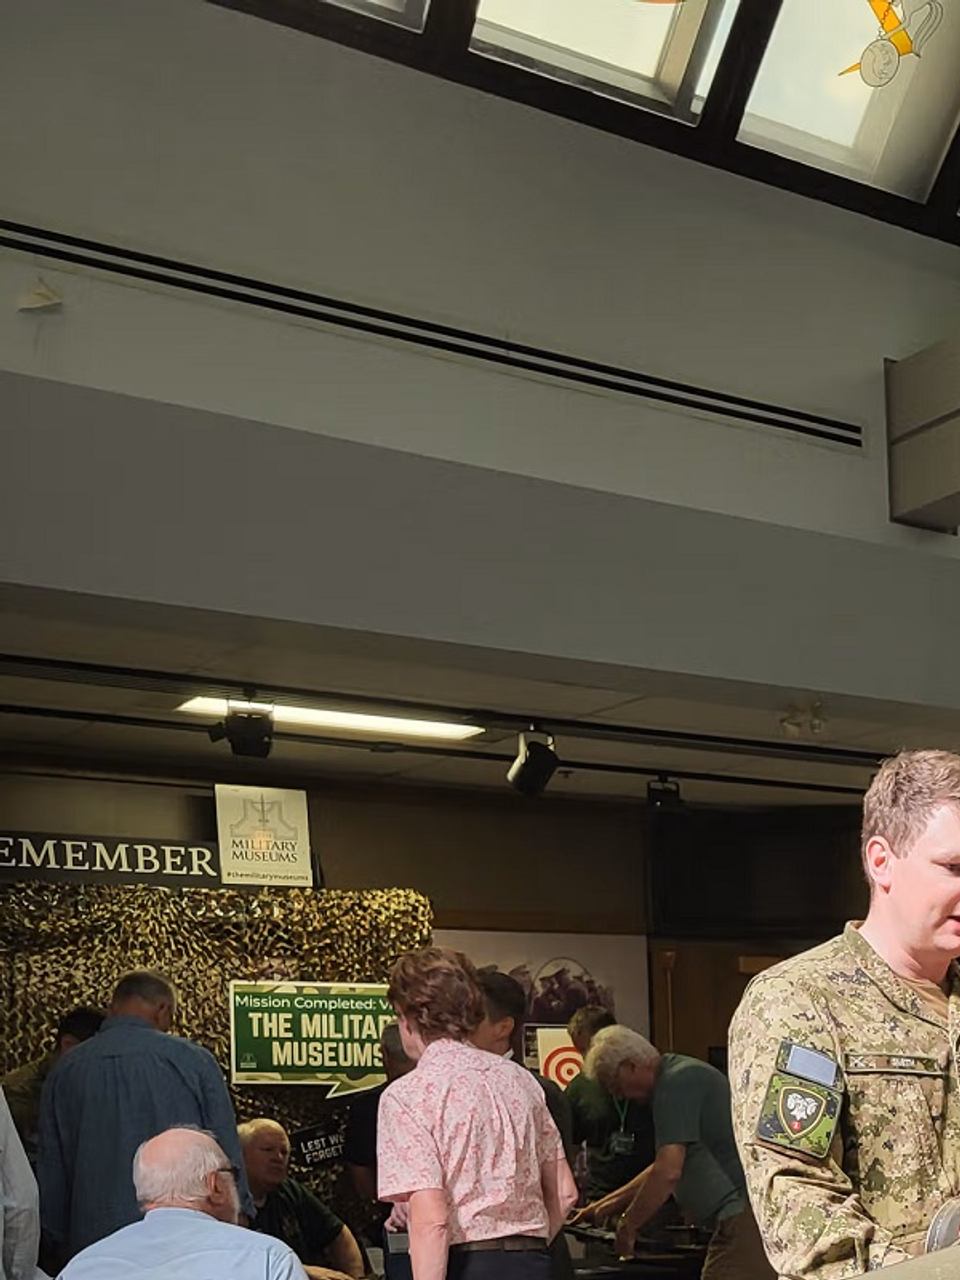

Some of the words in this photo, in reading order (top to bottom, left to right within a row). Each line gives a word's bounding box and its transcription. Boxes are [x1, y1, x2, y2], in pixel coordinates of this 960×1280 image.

[231, 839, 298, 852] MILITARY
[231, 851, 298, 863] MUSEUMS
[236, 995, 291, 1009] Mission
[294, 997, 377, 1012] Completed:
[248, 1012, 294, 1038] THE
[271, 1041, 384, 1067] MUSEUMS
[300, 1137, 326, 1154] LEST
[305, 1144, 343, 1164] FORGET
